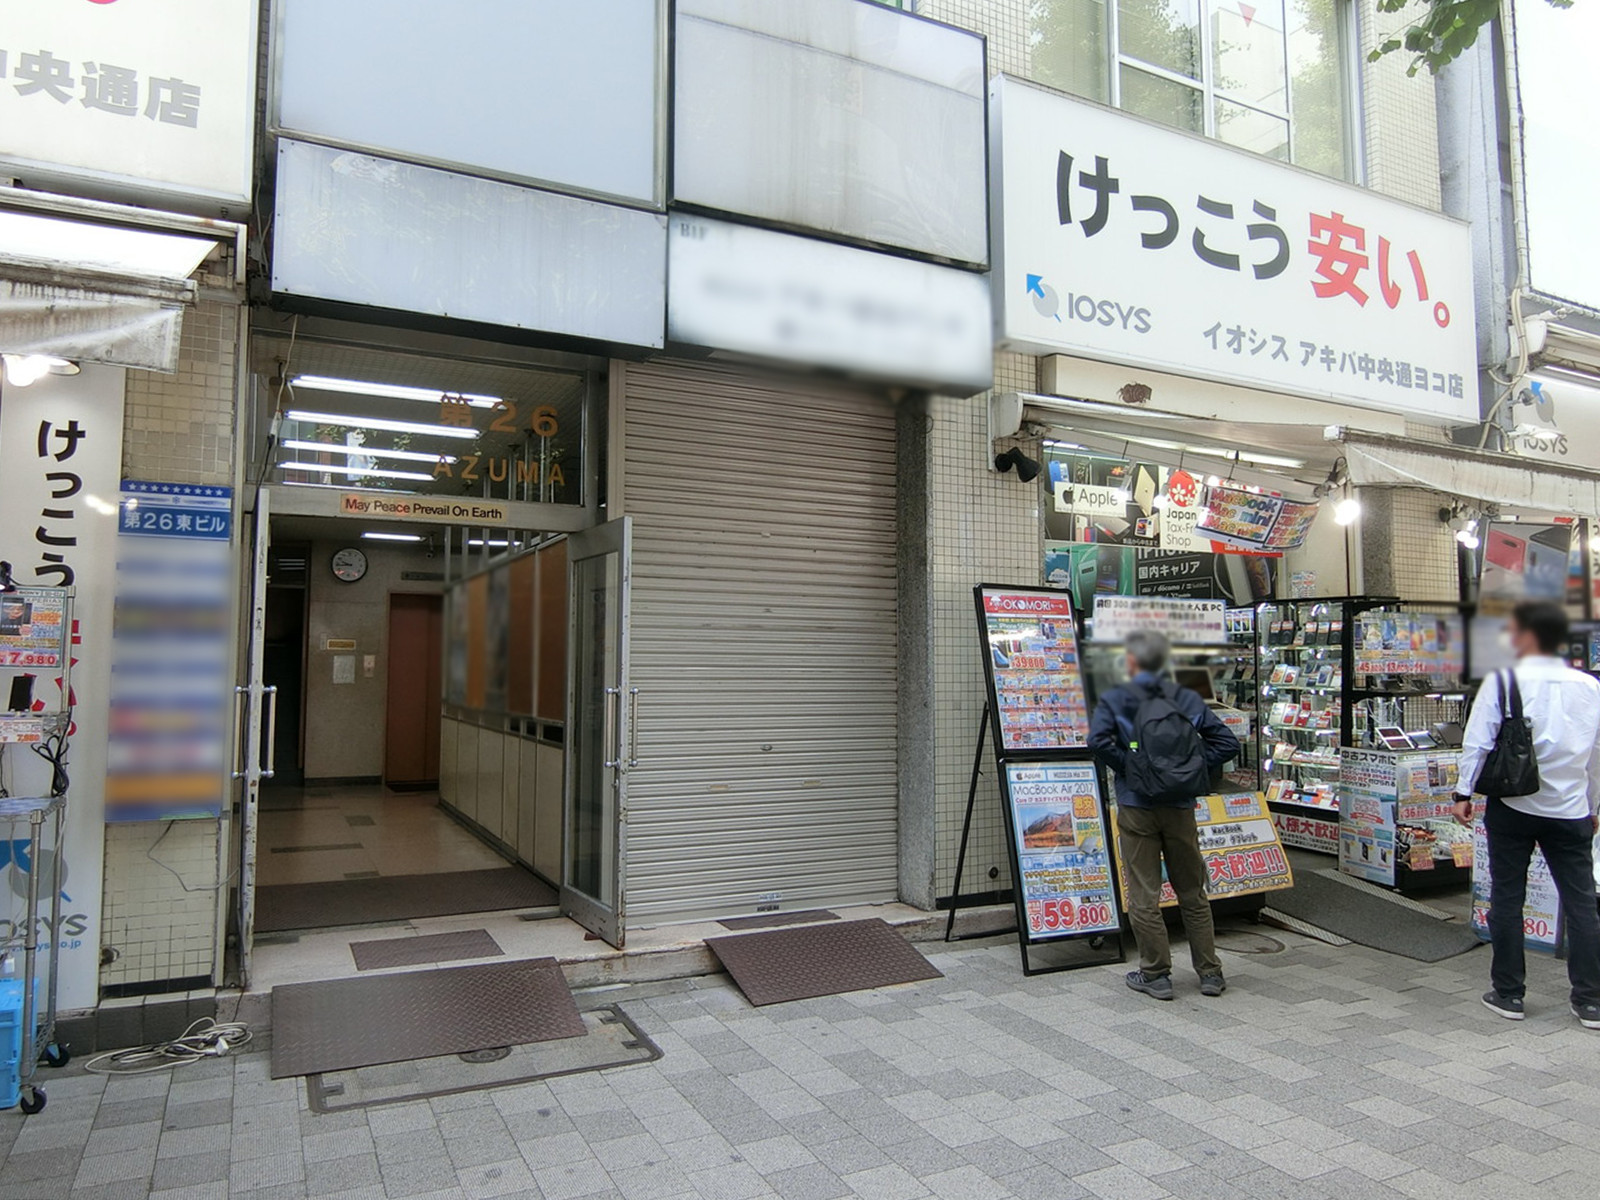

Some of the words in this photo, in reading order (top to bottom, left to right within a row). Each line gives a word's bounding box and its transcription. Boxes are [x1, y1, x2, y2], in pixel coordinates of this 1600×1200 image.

[1056, 149, 1451, 329] けっこう安い。
[1068, 292, 1152, 334] IOSYS
[1203, 321, 1290, 362] イオシス
[1299, 340, 1464, 399] アキバ中央通ヨコ店
[432, 454, 565, 486] AZUMA
[1079, 488, 1118, 507] Apple
[345, 498, 371, 511] May
[373, 501, 411, 513] Peace
[413, 503, 450, 515] Prevail
[452, 505, 469, 517] On
[472, 507, 502, 519] Earth
[1166, 508, 1197, 521] Japan
[124, 511, 226, 533] 第26東ビル
[1166, 534, 1192, 548] Shop
[1138, 561, 1200, 579] 国内キャリア
[10, 652, 56, 665] 7,980
[1341, 751, 1396, 765] 中古スマホに
[1013, 784, 1058, 795] MacBook
[1061, 784, 1072, 793] Air
[1074, 782, 1094, 793] 2017
